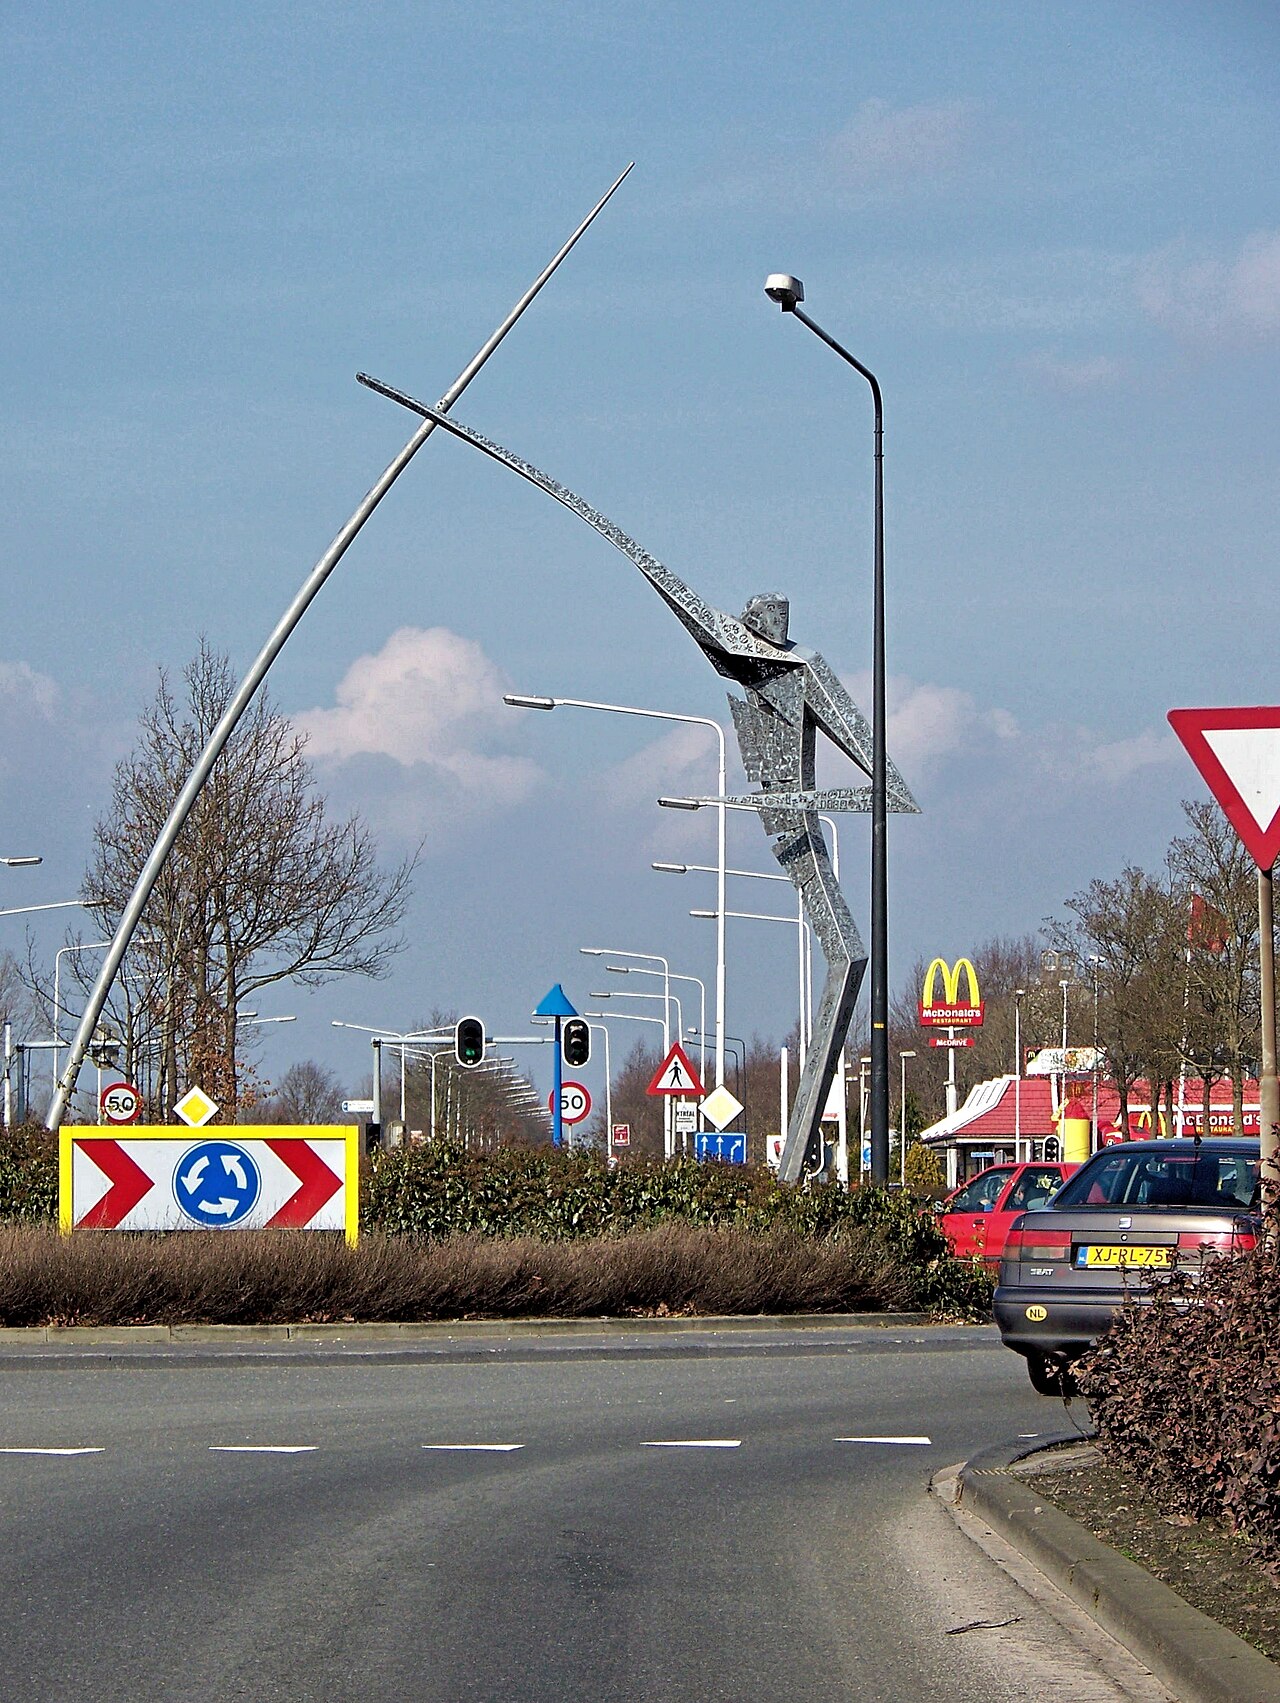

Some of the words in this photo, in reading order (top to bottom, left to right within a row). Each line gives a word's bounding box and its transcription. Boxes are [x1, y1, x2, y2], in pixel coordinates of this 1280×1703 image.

[922, 1009, 981, 1018] McDonald's
[109, 1096, 134, 1111] 50
[561, 1095, 583, 1109] 50
[1172, 1114, 1261, 1126] McDonad's
[1093, 1248, 1164, 1262] XJ-RL-75
[1029, 1309, 1044, 1318] NL
